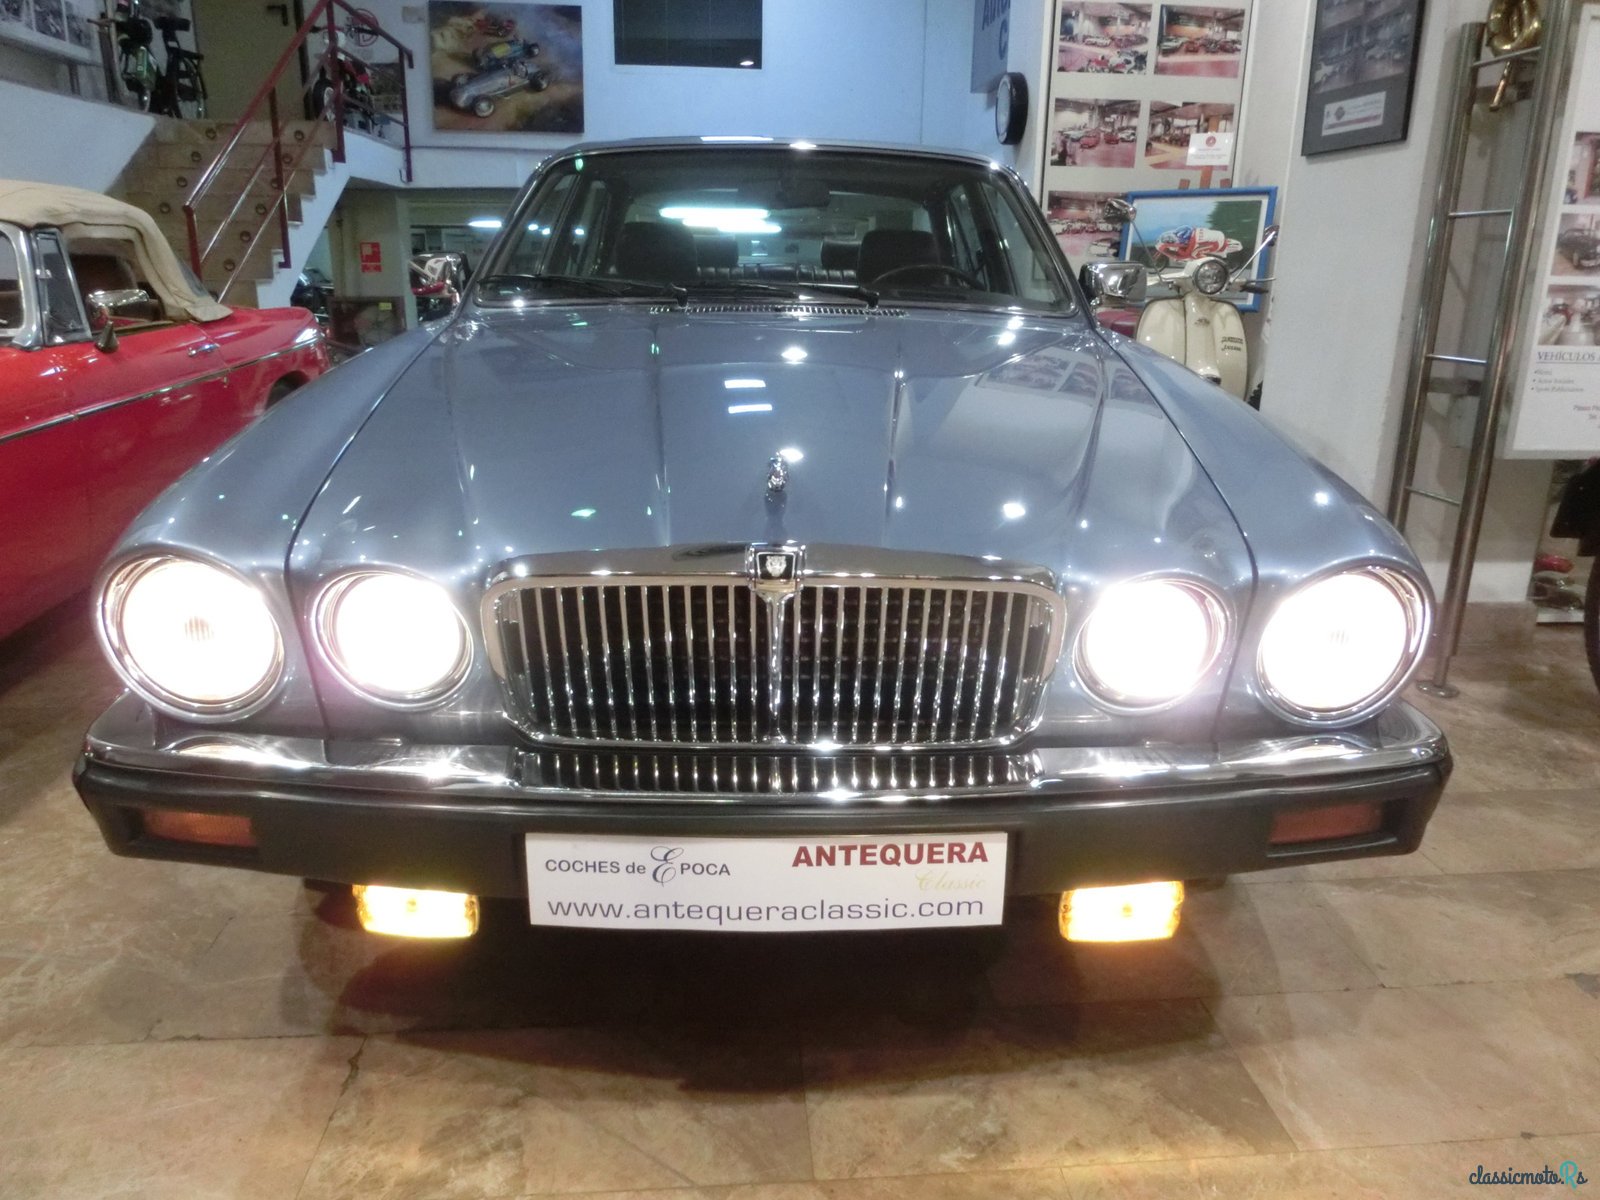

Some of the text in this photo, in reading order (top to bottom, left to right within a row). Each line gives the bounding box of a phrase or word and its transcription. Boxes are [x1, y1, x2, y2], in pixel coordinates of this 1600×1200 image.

[545, 859, 620, 874] COCHES
[625, 861, 646, 874] de
[792, 841, 989, 867] ANTEQUERA
[914, 869, 987, 893] Classic
[547, 898, 984, 926] www.antequeraclassic.com
